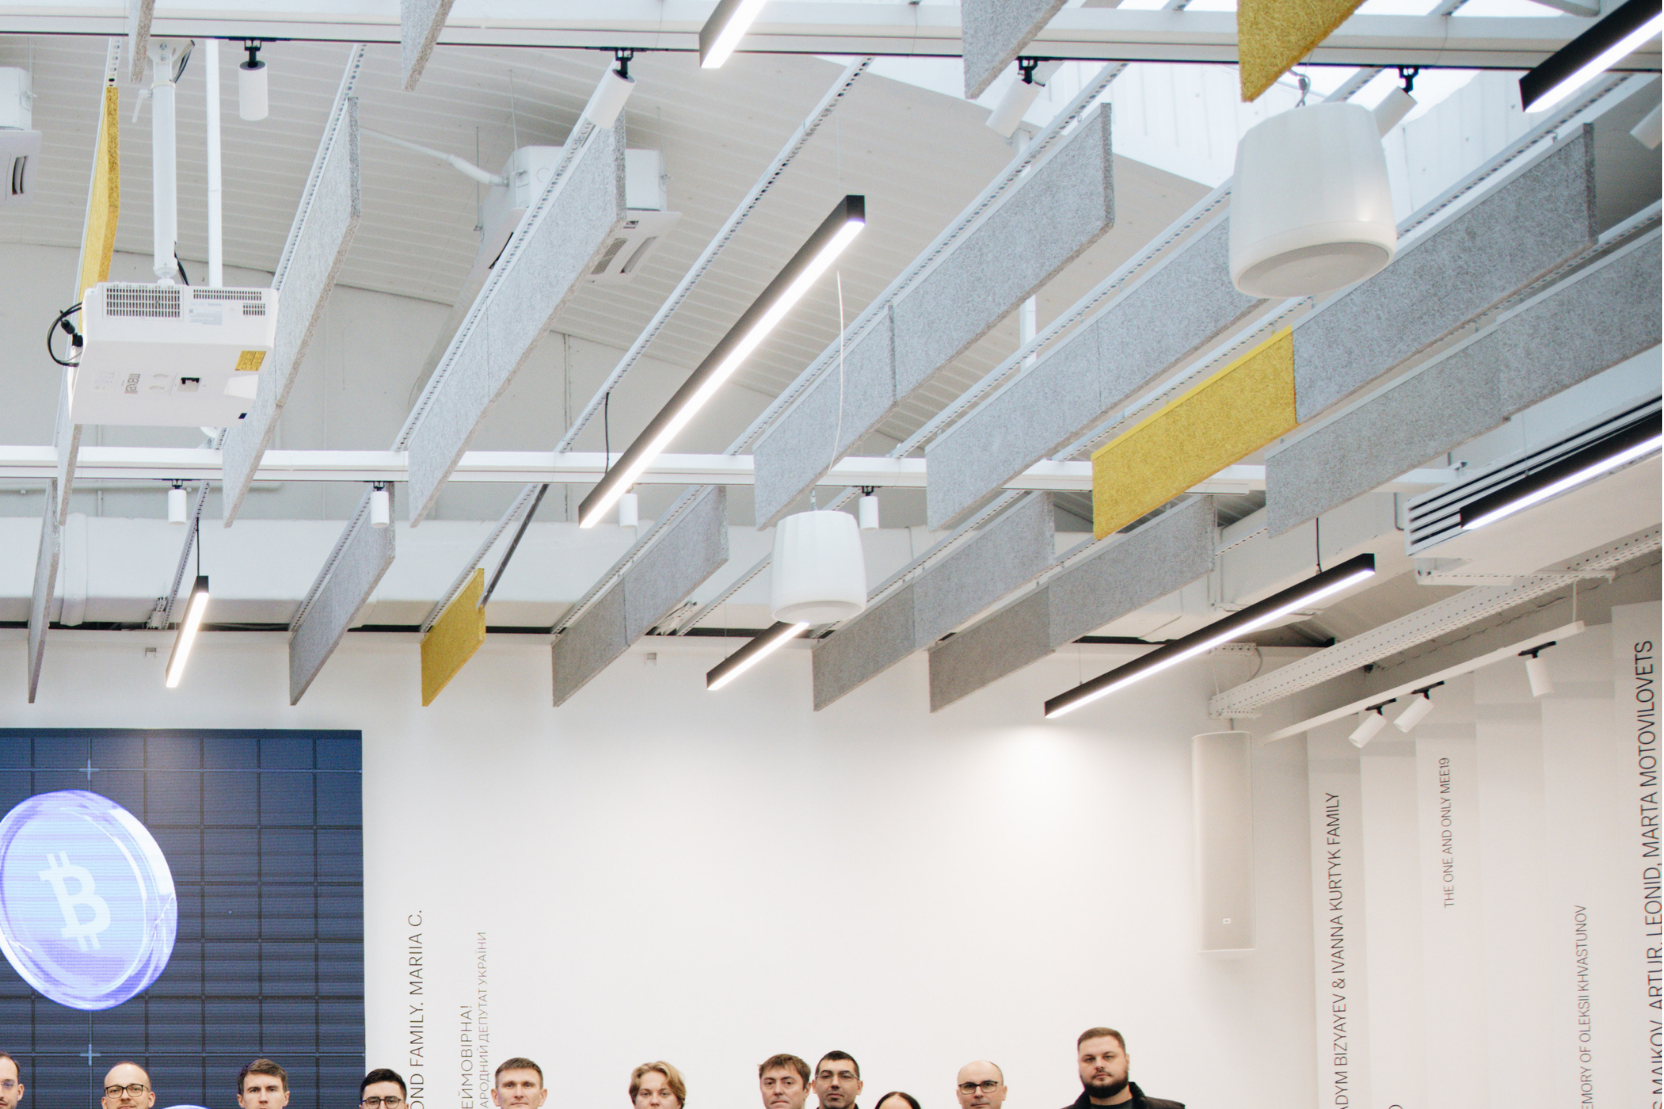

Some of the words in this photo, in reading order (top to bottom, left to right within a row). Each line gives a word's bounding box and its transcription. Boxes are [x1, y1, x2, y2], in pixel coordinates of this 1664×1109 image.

[1634, 640, 1656, 786] MOTOVILOVETS
[1325, 793, 1340, 845] FAMILY
[1441, 797, 1452, 827] ONLY
[1640, 792, 1659, 857] MARTA
[1441, 830, 1453, 854] AND
[1328, 849, 1342, 910] KURTYK
[1442, 857, 1454, 882] ONE
[1443, 885, 1454, 909] THE
[409, 932, 424, 995] MARIIA
[475, 931, 487, 985] УКРАЇНИ
[1330, 915, 1344, 973] IVANNA
[1575, 905, 1589, 992] KHVASTUNOV
[1332, 979, 1345, 989] &
[410, 1003, 423, 1066] FAMILY.
[478, 988, 490, 1042] ДЕПУТАТ
[1333, 994, 1347, 1066] BIZYAYEV
[1577, 995, 1591, 1042] OLEKSII
[1579, 1045, 1592, 1063] OF
